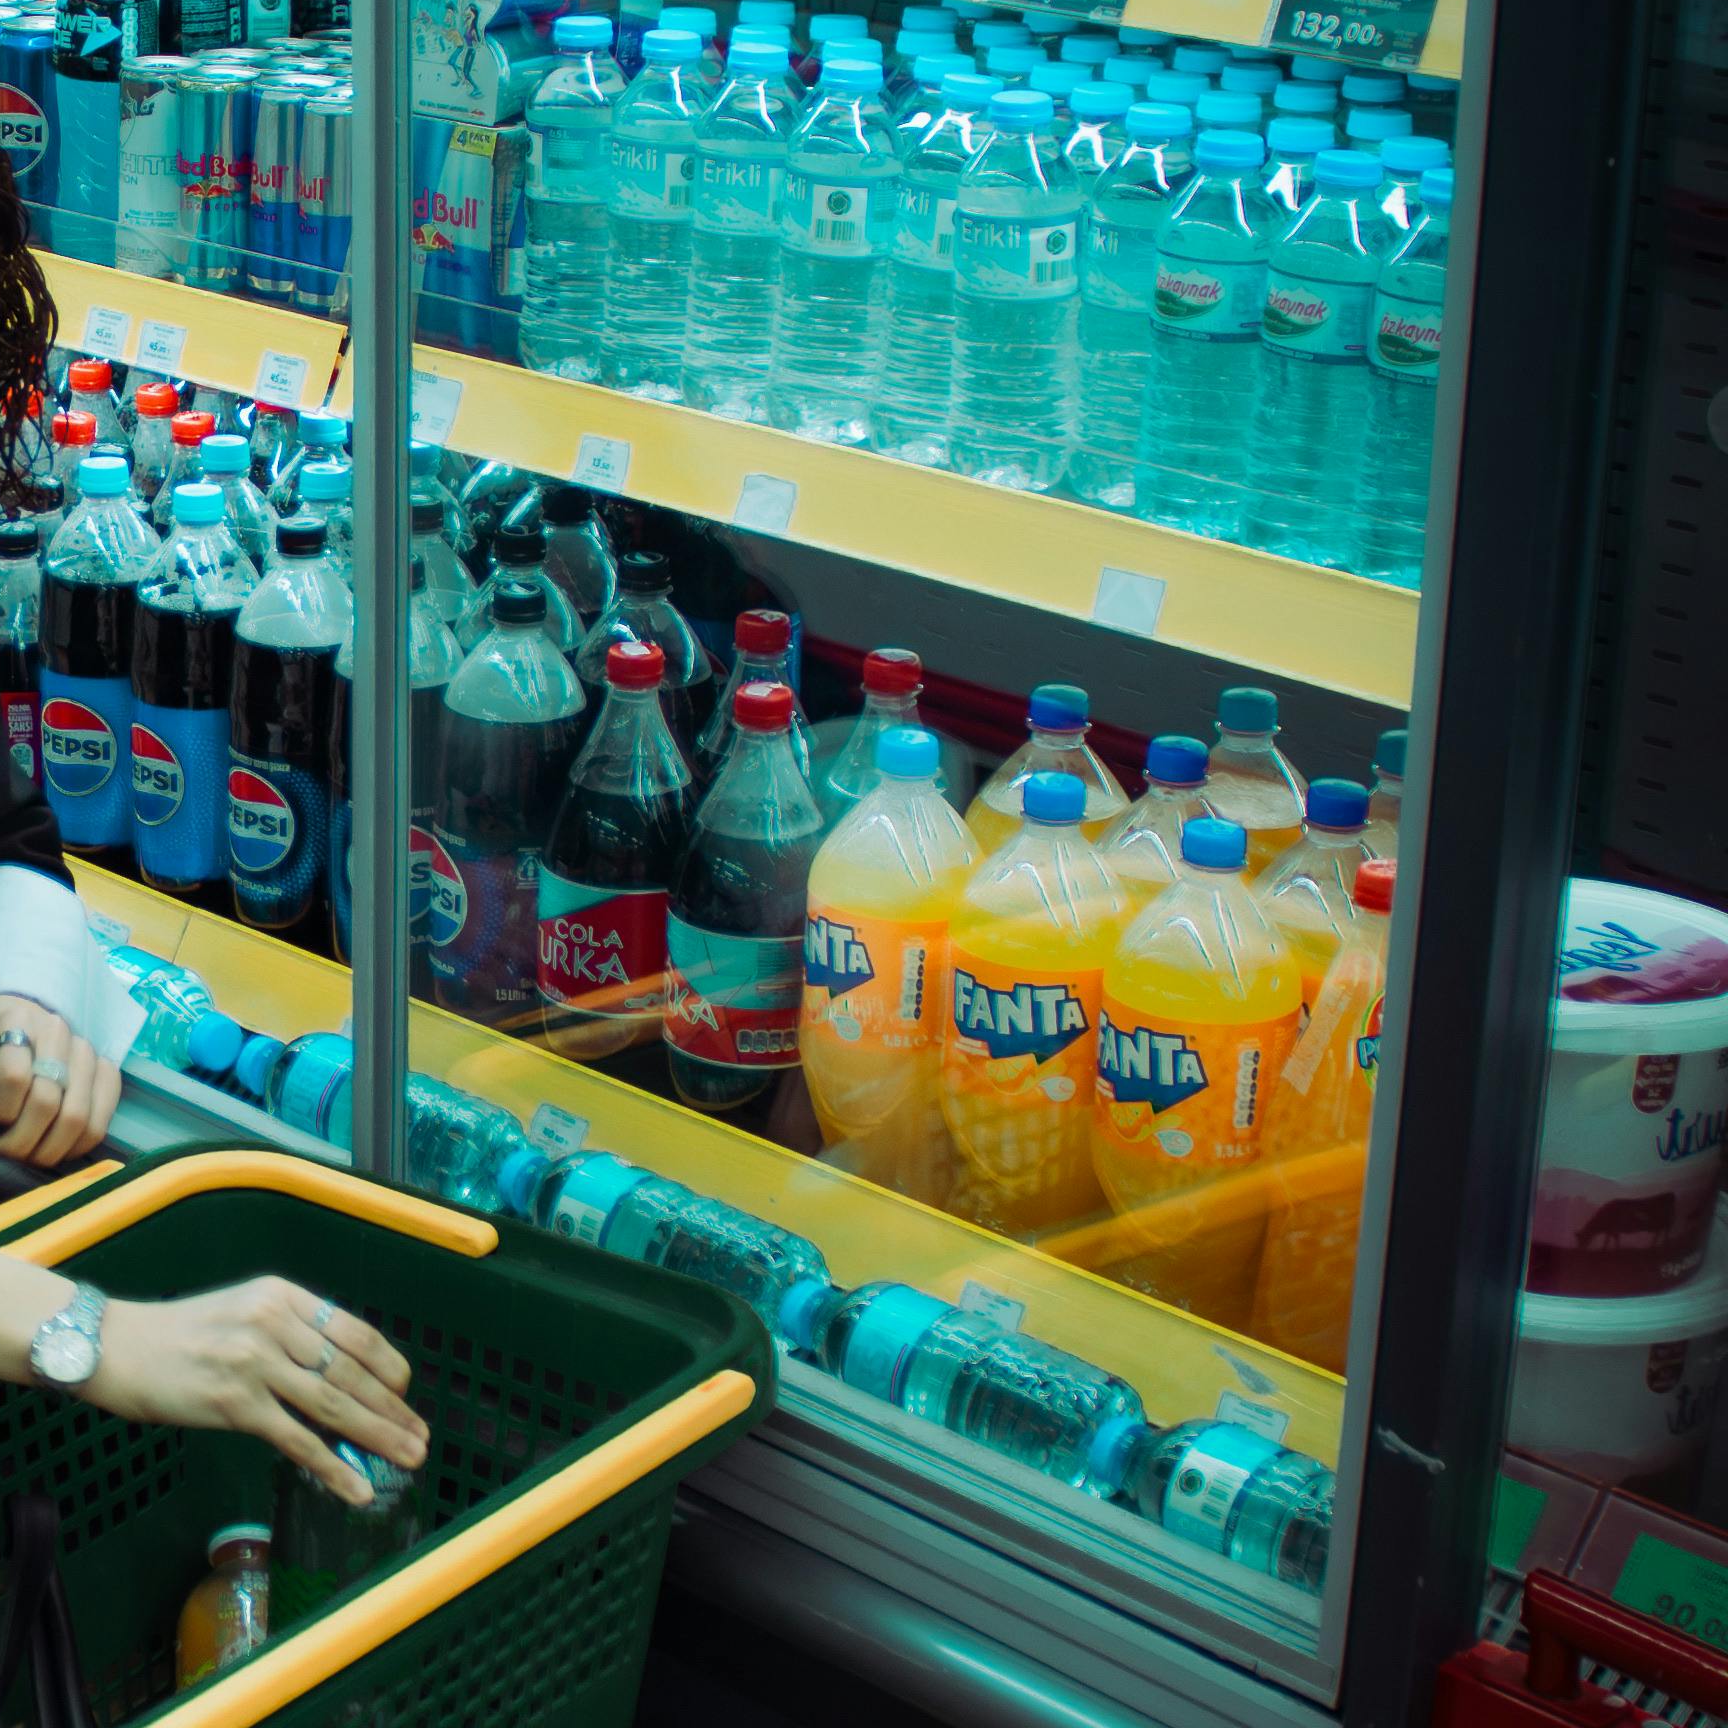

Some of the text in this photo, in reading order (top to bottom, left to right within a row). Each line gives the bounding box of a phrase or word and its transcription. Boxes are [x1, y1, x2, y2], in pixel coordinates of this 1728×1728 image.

[703, 160, 761, 188] Erikli
[433, 191, 478, 229] Bull
[554, 918, 624, 949] COLA
[955, 968, 1088, 1036] FANTA
